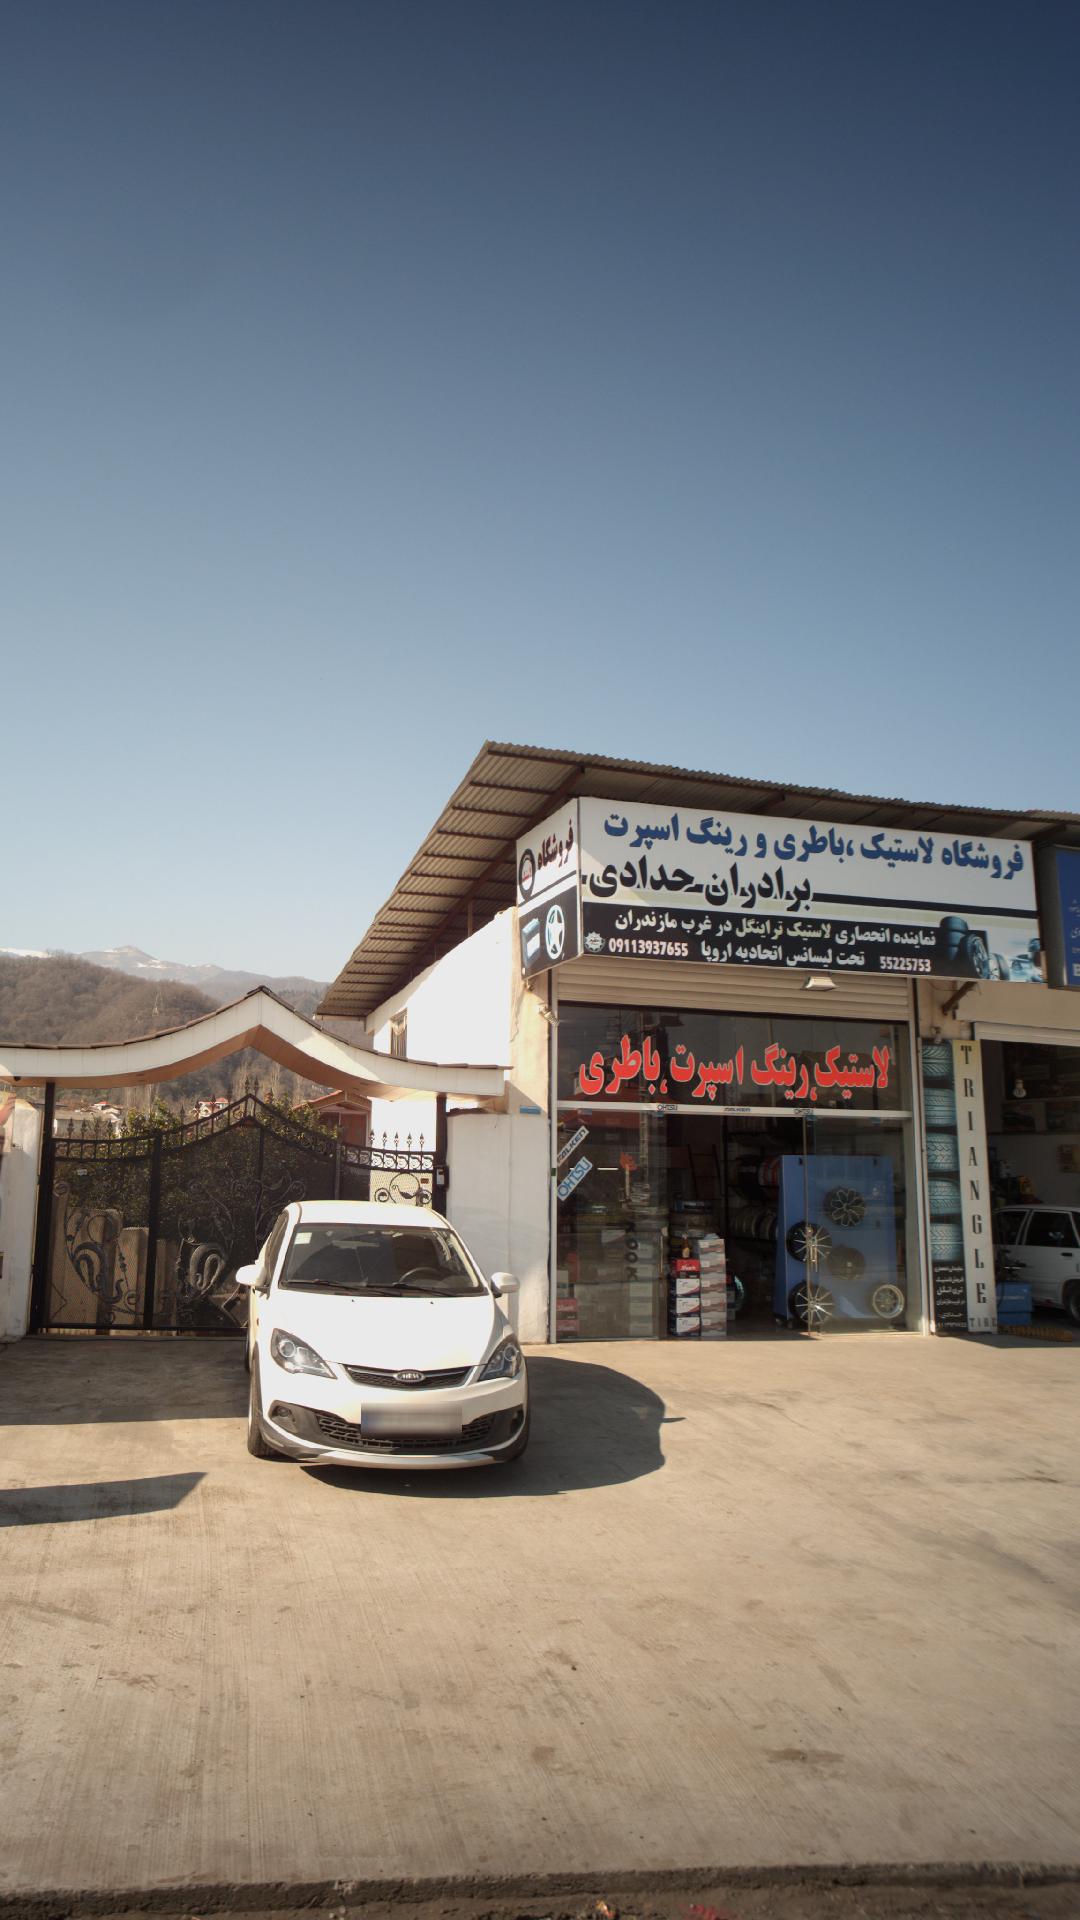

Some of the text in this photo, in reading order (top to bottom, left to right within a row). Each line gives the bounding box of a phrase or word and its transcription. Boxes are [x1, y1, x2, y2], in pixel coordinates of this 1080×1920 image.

[538, 817, 574, 870] فروشگاه
[604, 813, 679, 850] اسپرت
[686, 817, 748, 854] رینگ
[754, 832, 767, 858] و
[860, 833, 934, 868] لاستیک
[941, 839, 1024, 880] فروشگاه
[589, 855, 811, 912] برادران حدادی
[615, 909, 677, 932] مازندران
[681, 915, 712, 936] غرب
[716, 919, 732, 937] در
[787, 922, 832, 941] لاستیک
[835, 926, 890, 946] انحصاری
[608, 938, 689, 957] 09113937655
[700, 940, 865, 967] تحت لیسانس اتحادیه اروپا
[893, 929, 936, 949] نماینده
[880, 956, 931, 972] 55225753
[579, 1034, 660, 1095] باطری
[751, 1043, 809, 1099] رینگ
[657, 1103, 678, 1112] OHTSU
[557, 1128, 587, 1165] FALKEN
[557, 1158, 592, 1199] OHTSU
[960, 1045, 987, 1304] TRIANGLE
